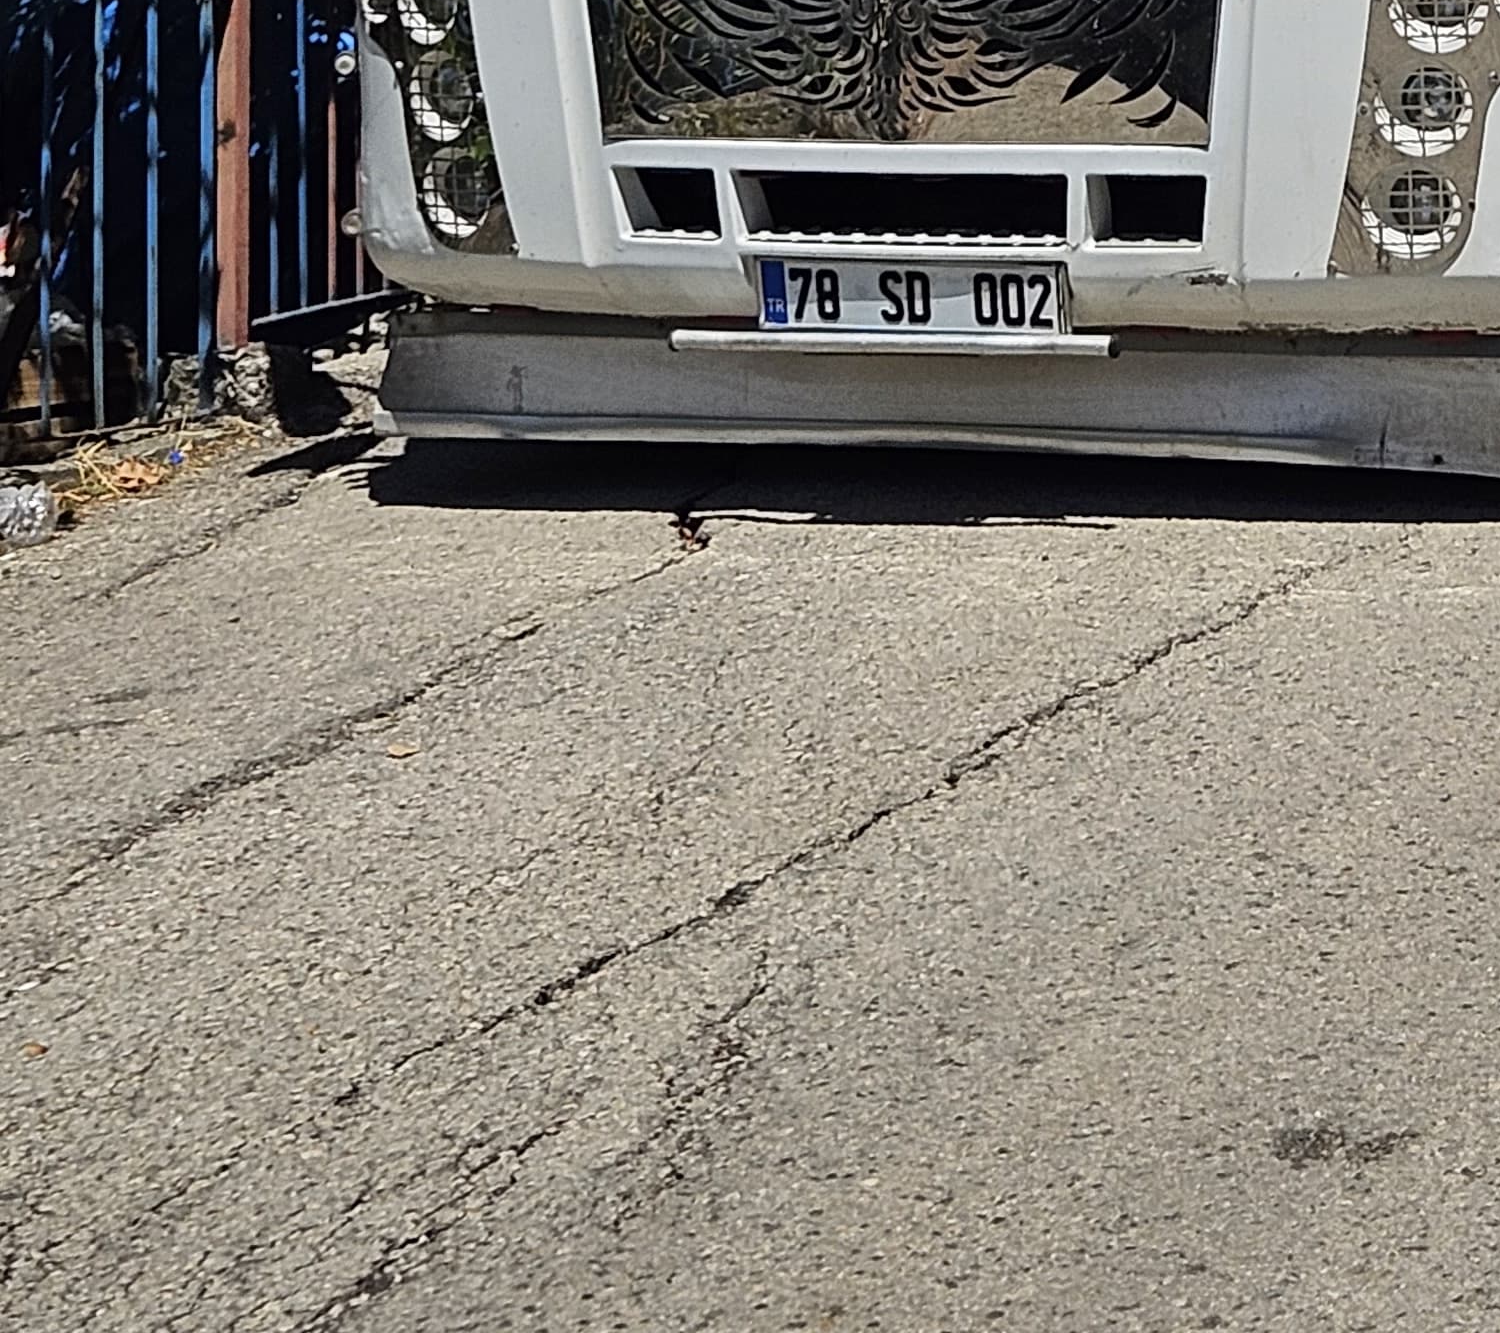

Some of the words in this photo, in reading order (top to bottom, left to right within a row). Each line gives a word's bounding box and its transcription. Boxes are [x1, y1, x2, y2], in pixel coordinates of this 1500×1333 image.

[766, 297, 785, 313] TR
[788, 268, 841, 322] 78
[878, 271, 932, 325] SD
[973, 272, 1054, 329] 002
